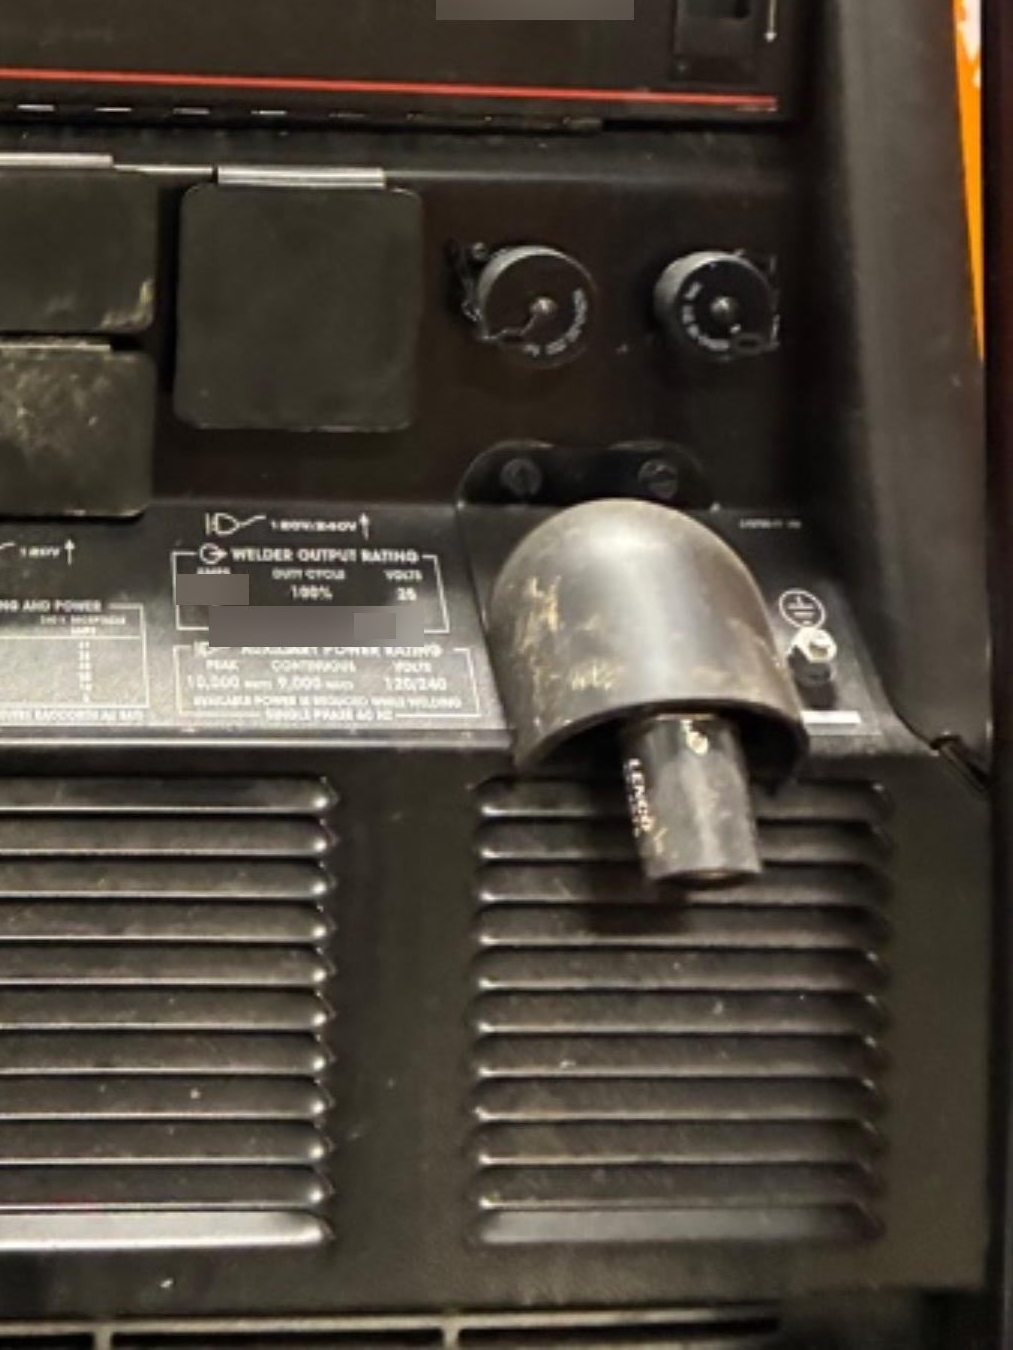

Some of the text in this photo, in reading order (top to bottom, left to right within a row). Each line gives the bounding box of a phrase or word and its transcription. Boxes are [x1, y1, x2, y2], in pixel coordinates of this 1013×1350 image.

[230, 547, 420, 564] WELDER OUTPUT RATING
[304, 568, 345, 580] CYCLE
[22, 599, 51, 613] AND
[54, 599, 102, 613] POWER
